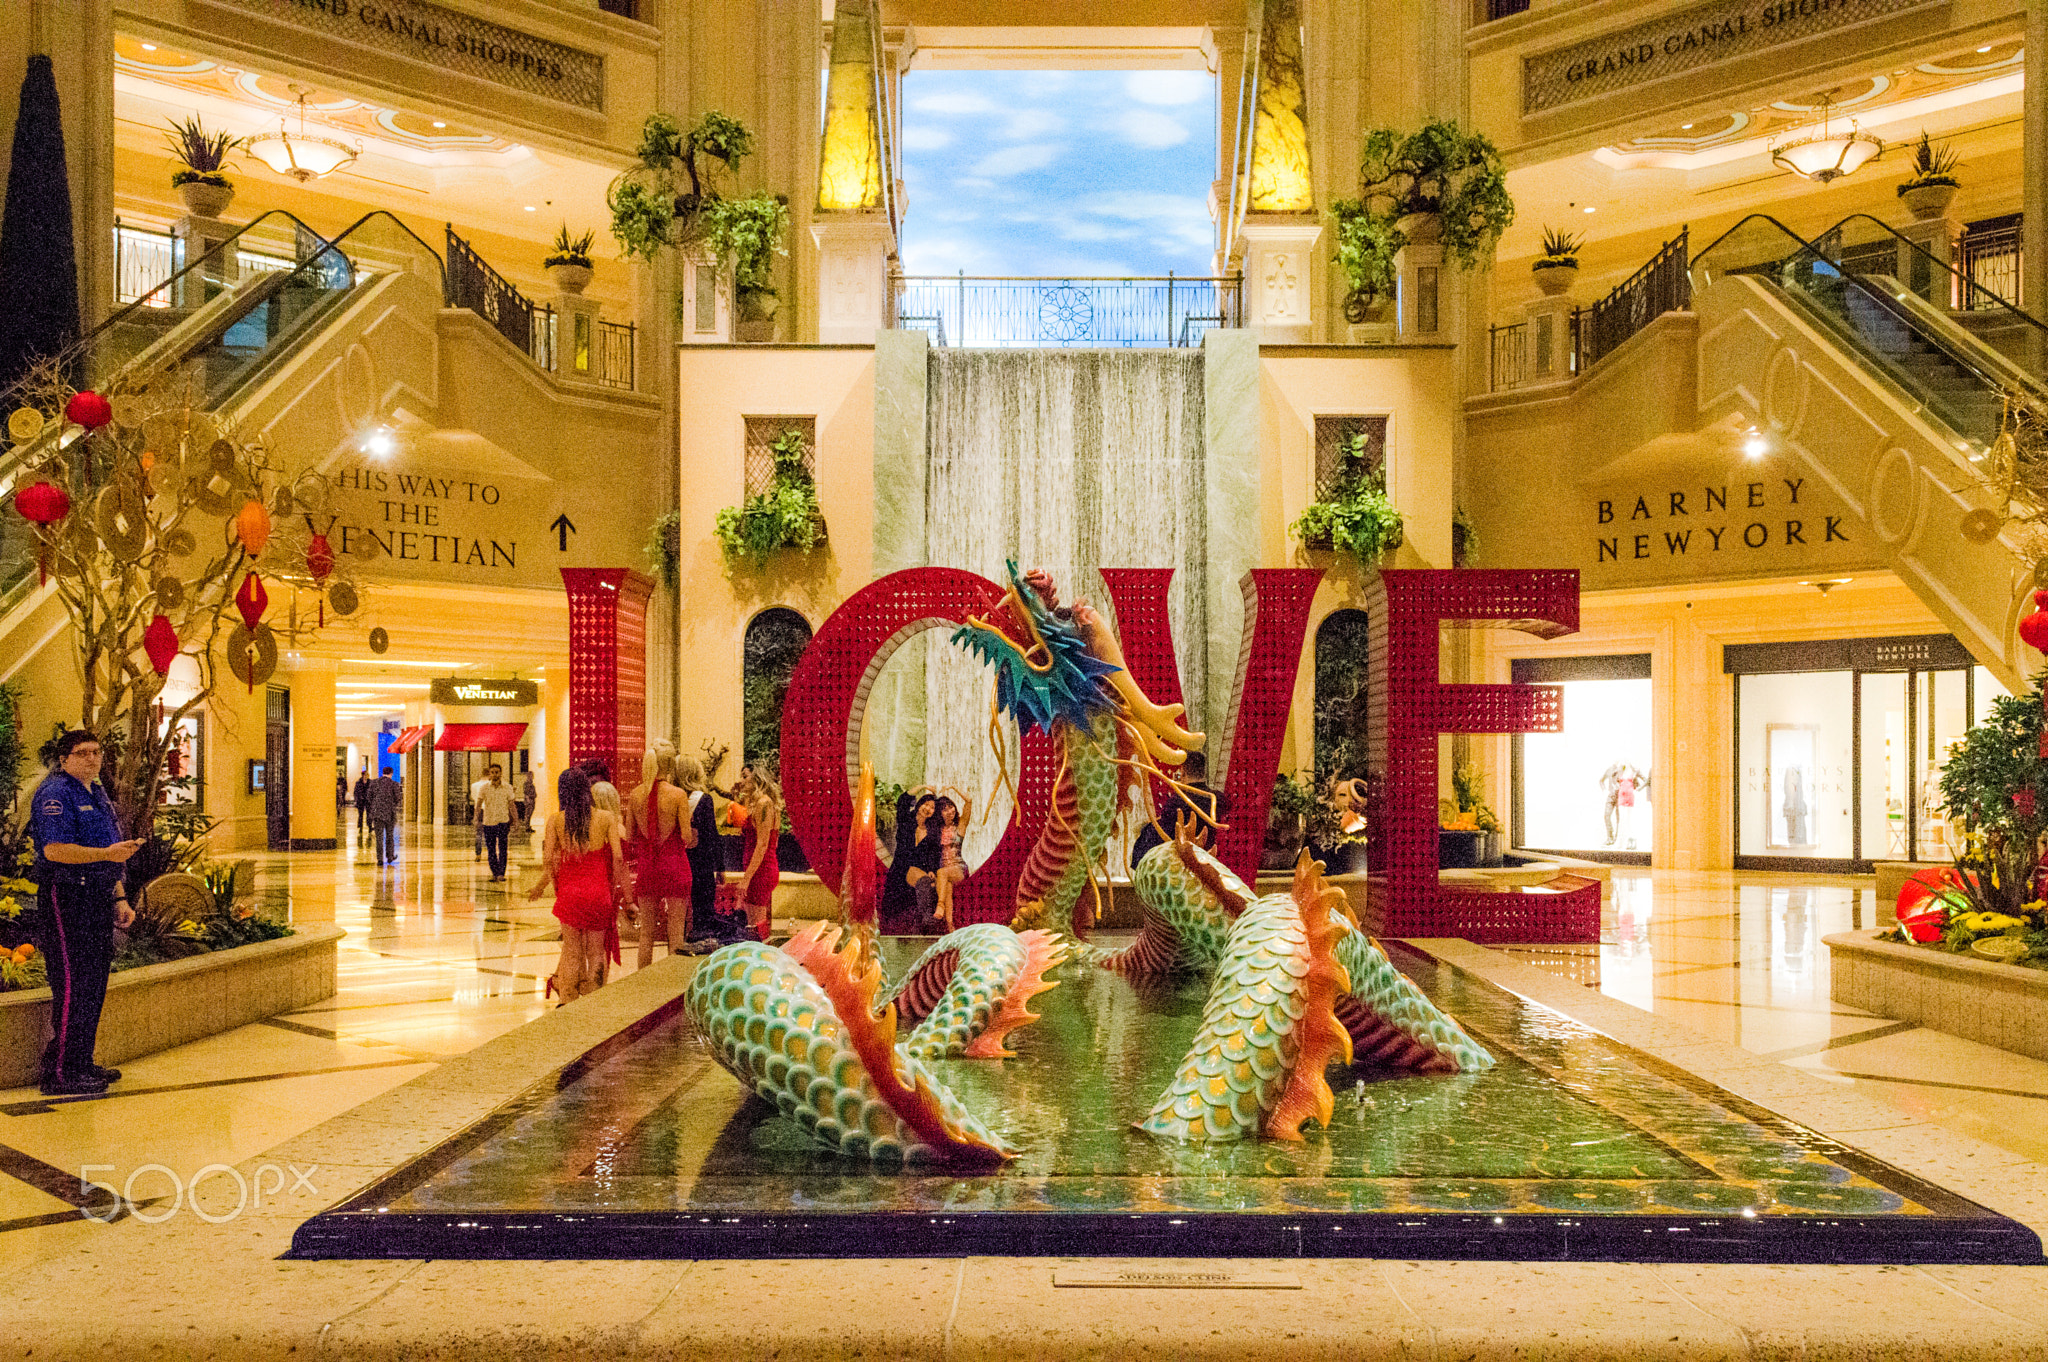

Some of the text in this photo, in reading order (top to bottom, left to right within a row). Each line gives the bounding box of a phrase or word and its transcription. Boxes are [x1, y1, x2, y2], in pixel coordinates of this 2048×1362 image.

[359, 5, 449, 47] CANAL
[457, 34, 562, 80] SHOPPES
[1566, 44, 1653, 82] GRAND
[1664, 15, 1752, 55] CANAL
[397, 474, 454, 499] WAY
[462, 482, 500, 504] TO
[1598, 478, 1803, 524] BARNEY
[378, 501, 439, 526] THE
[1877, 645, 1929, 653] BARNEYS
[453, 686, 516, 699] VENETIAN
